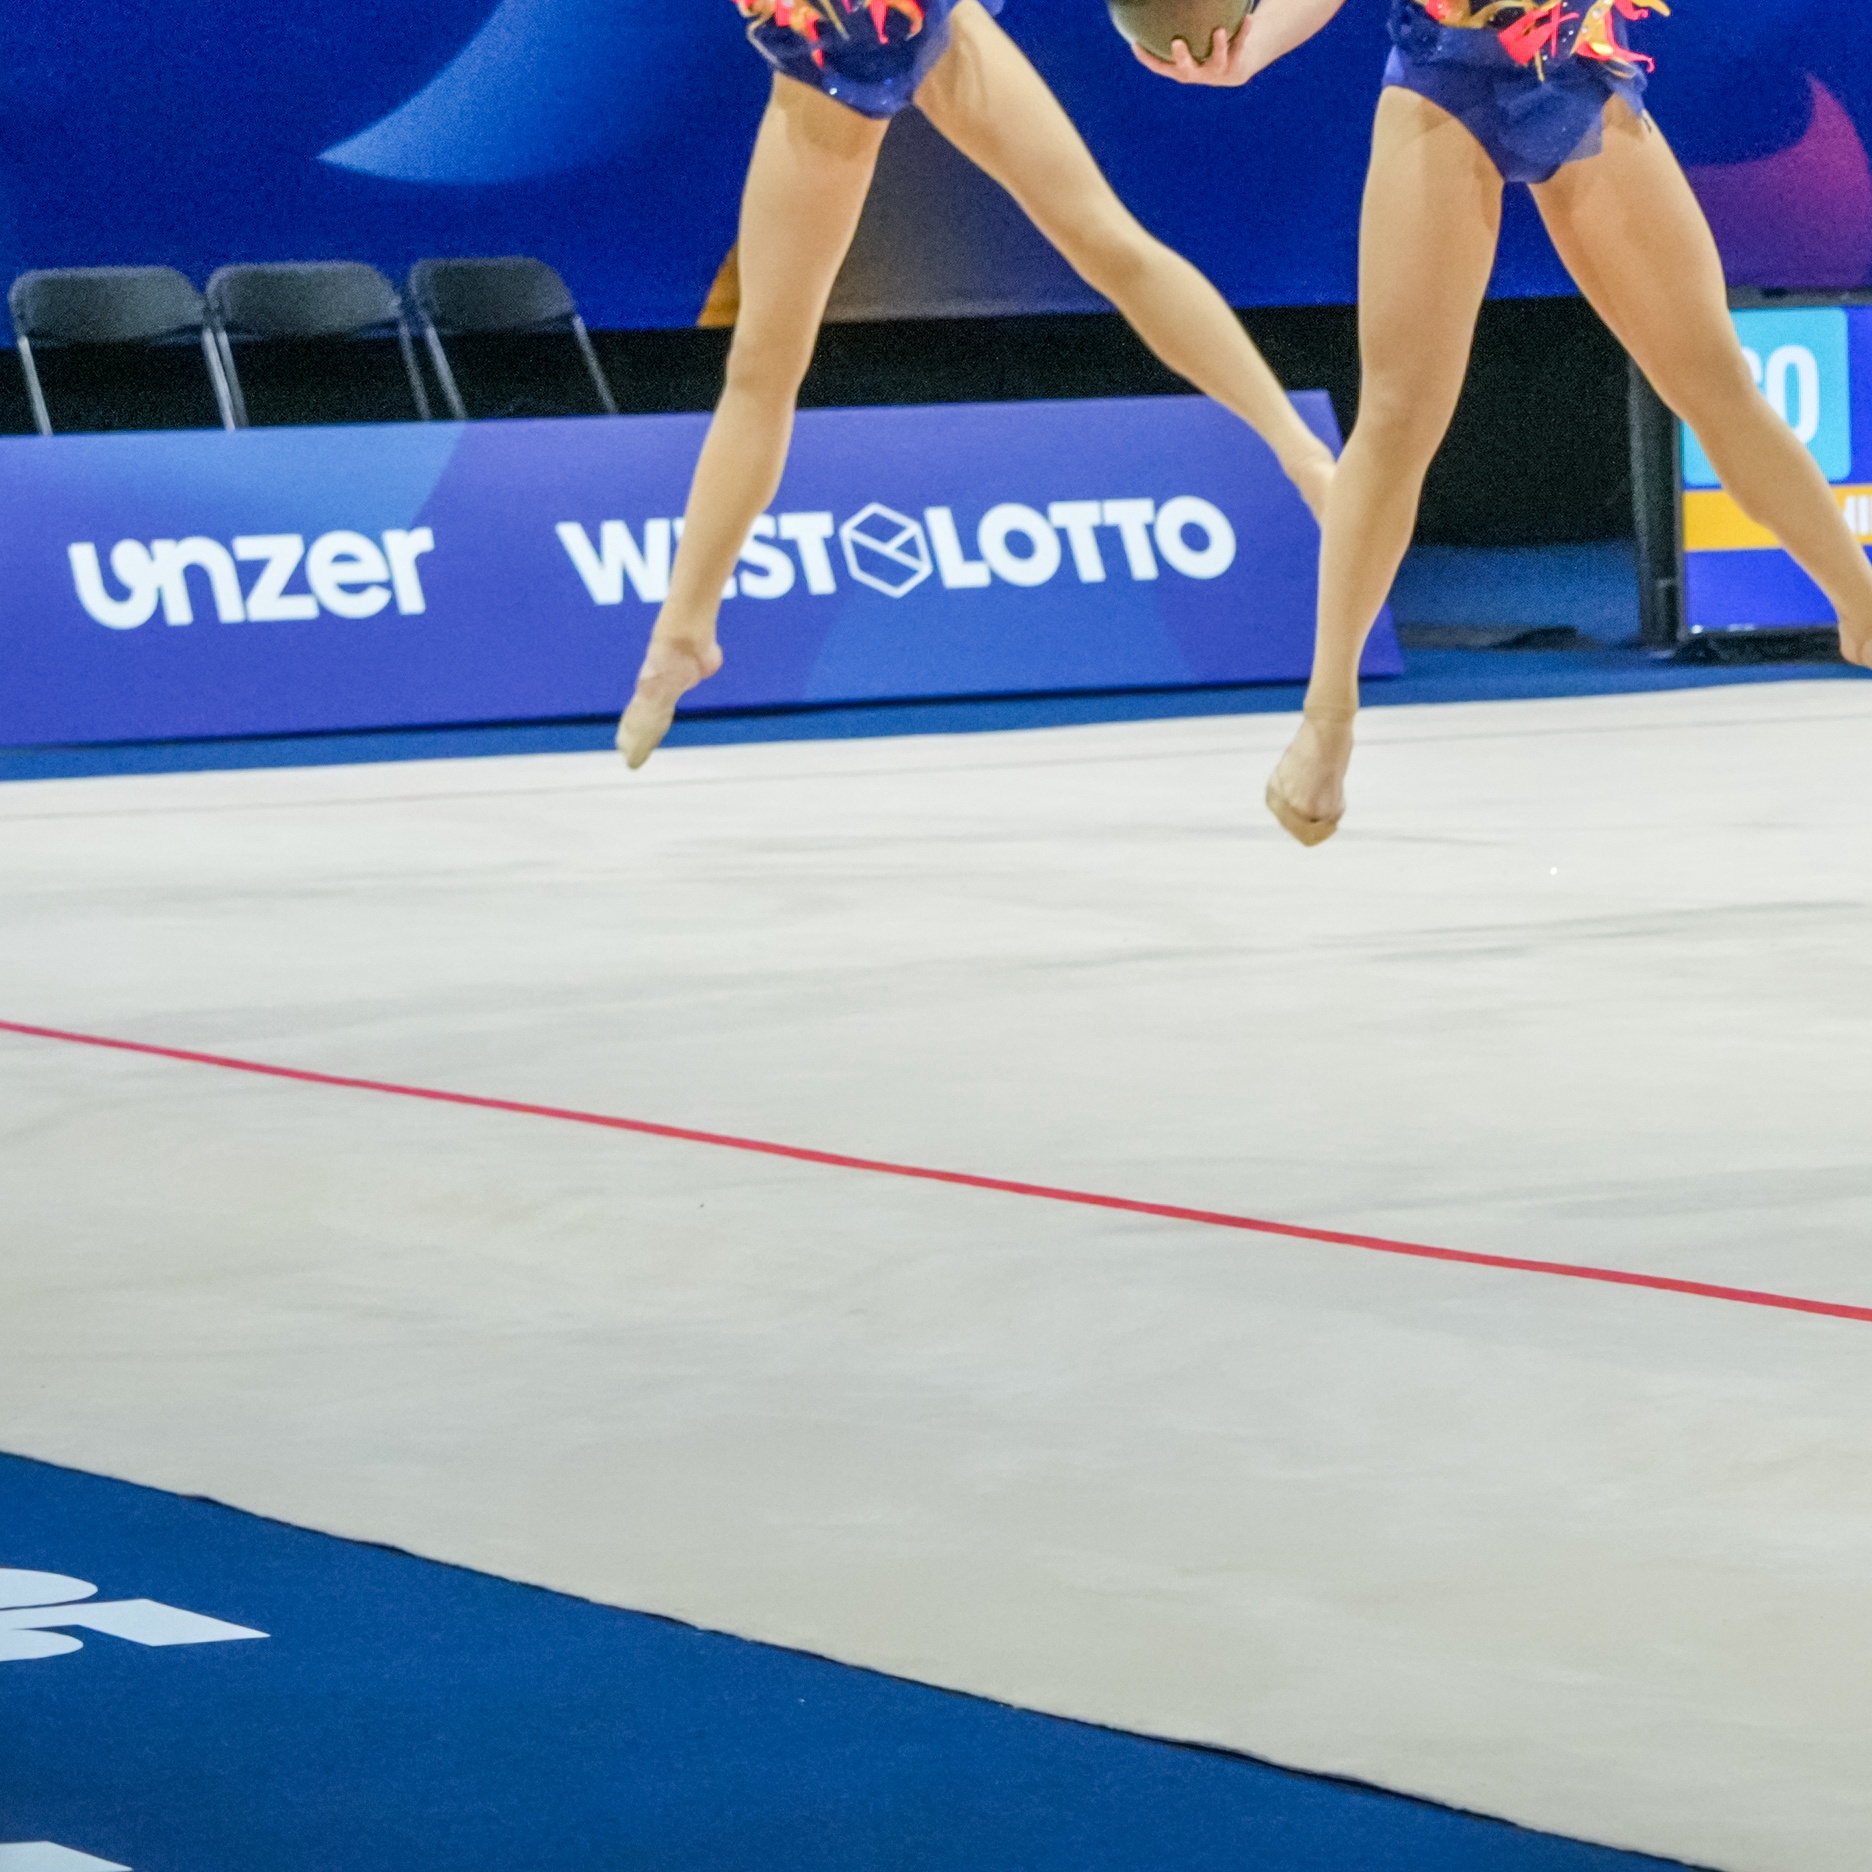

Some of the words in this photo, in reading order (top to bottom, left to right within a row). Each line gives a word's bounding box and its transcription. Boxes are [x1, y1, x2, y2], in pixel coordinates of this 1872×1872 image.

[67, 526, 434, 630] unzer
[555, 511, 837, 605] WST
[926, 495, 1237, 589] LOTTO
